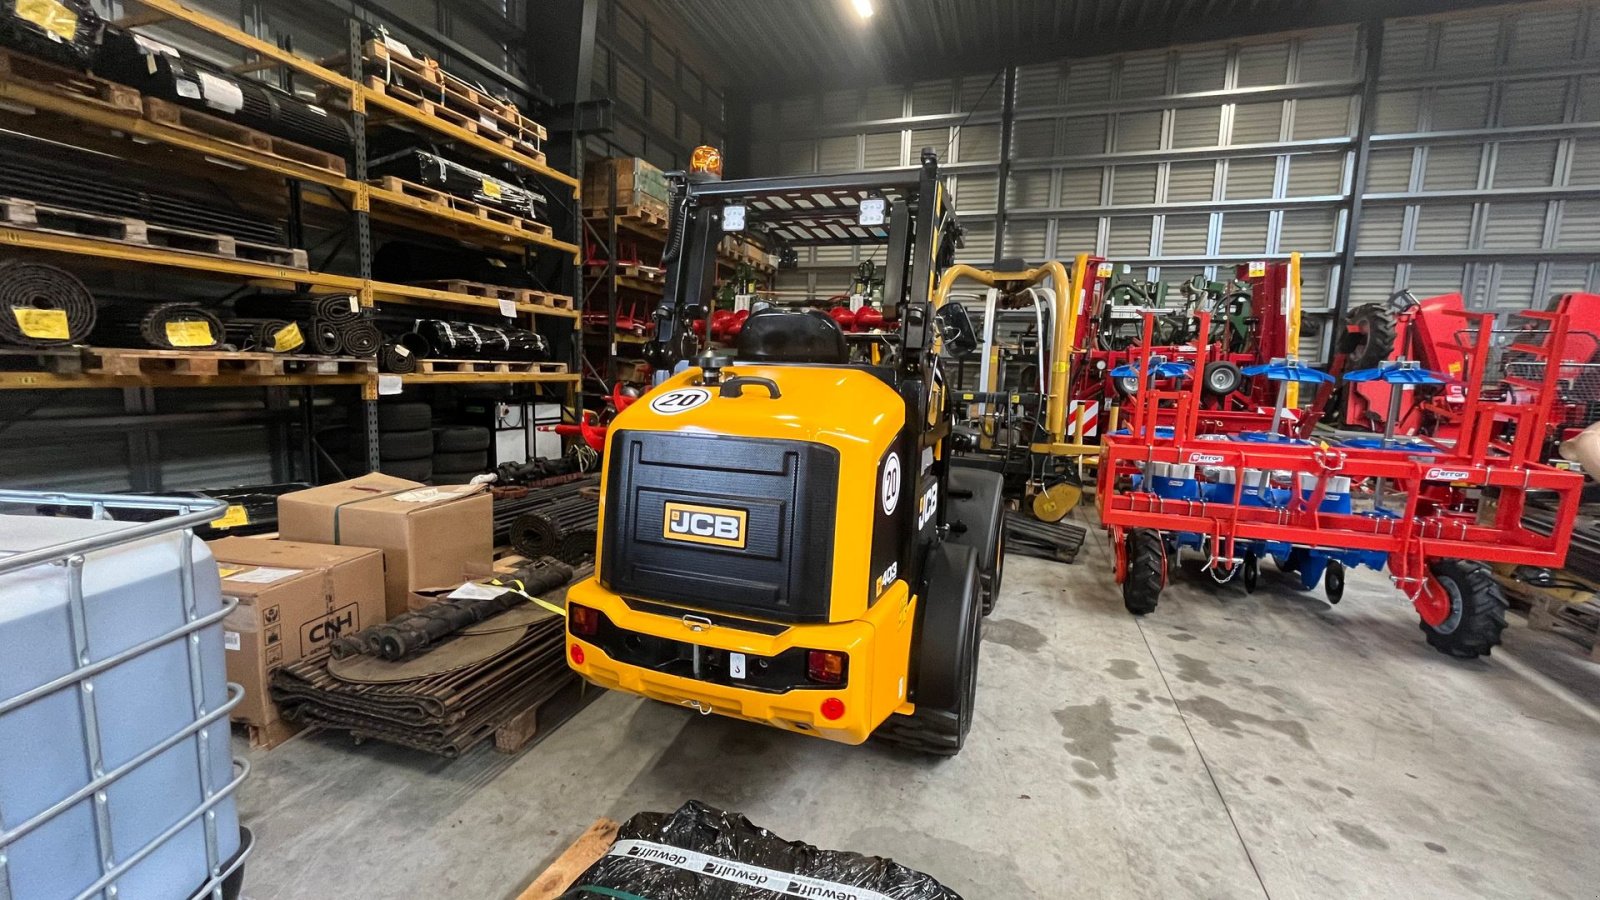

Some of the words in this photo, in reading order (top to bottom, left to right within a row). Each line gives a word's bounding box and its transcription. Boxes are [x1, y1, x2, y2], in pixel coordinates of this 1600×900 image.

[659, 393, 697, 408] 20
[885, 468, 898, 501] 20
[918, 482, 938, 531] JCB
[670, 511, 739, 539] JCB
[882, 561, 898, 586] 403
[309, 611, 352, 644] CNH
[638, 847, 687, 866] dewulf
[713, 863, 769, 885] dewulf
